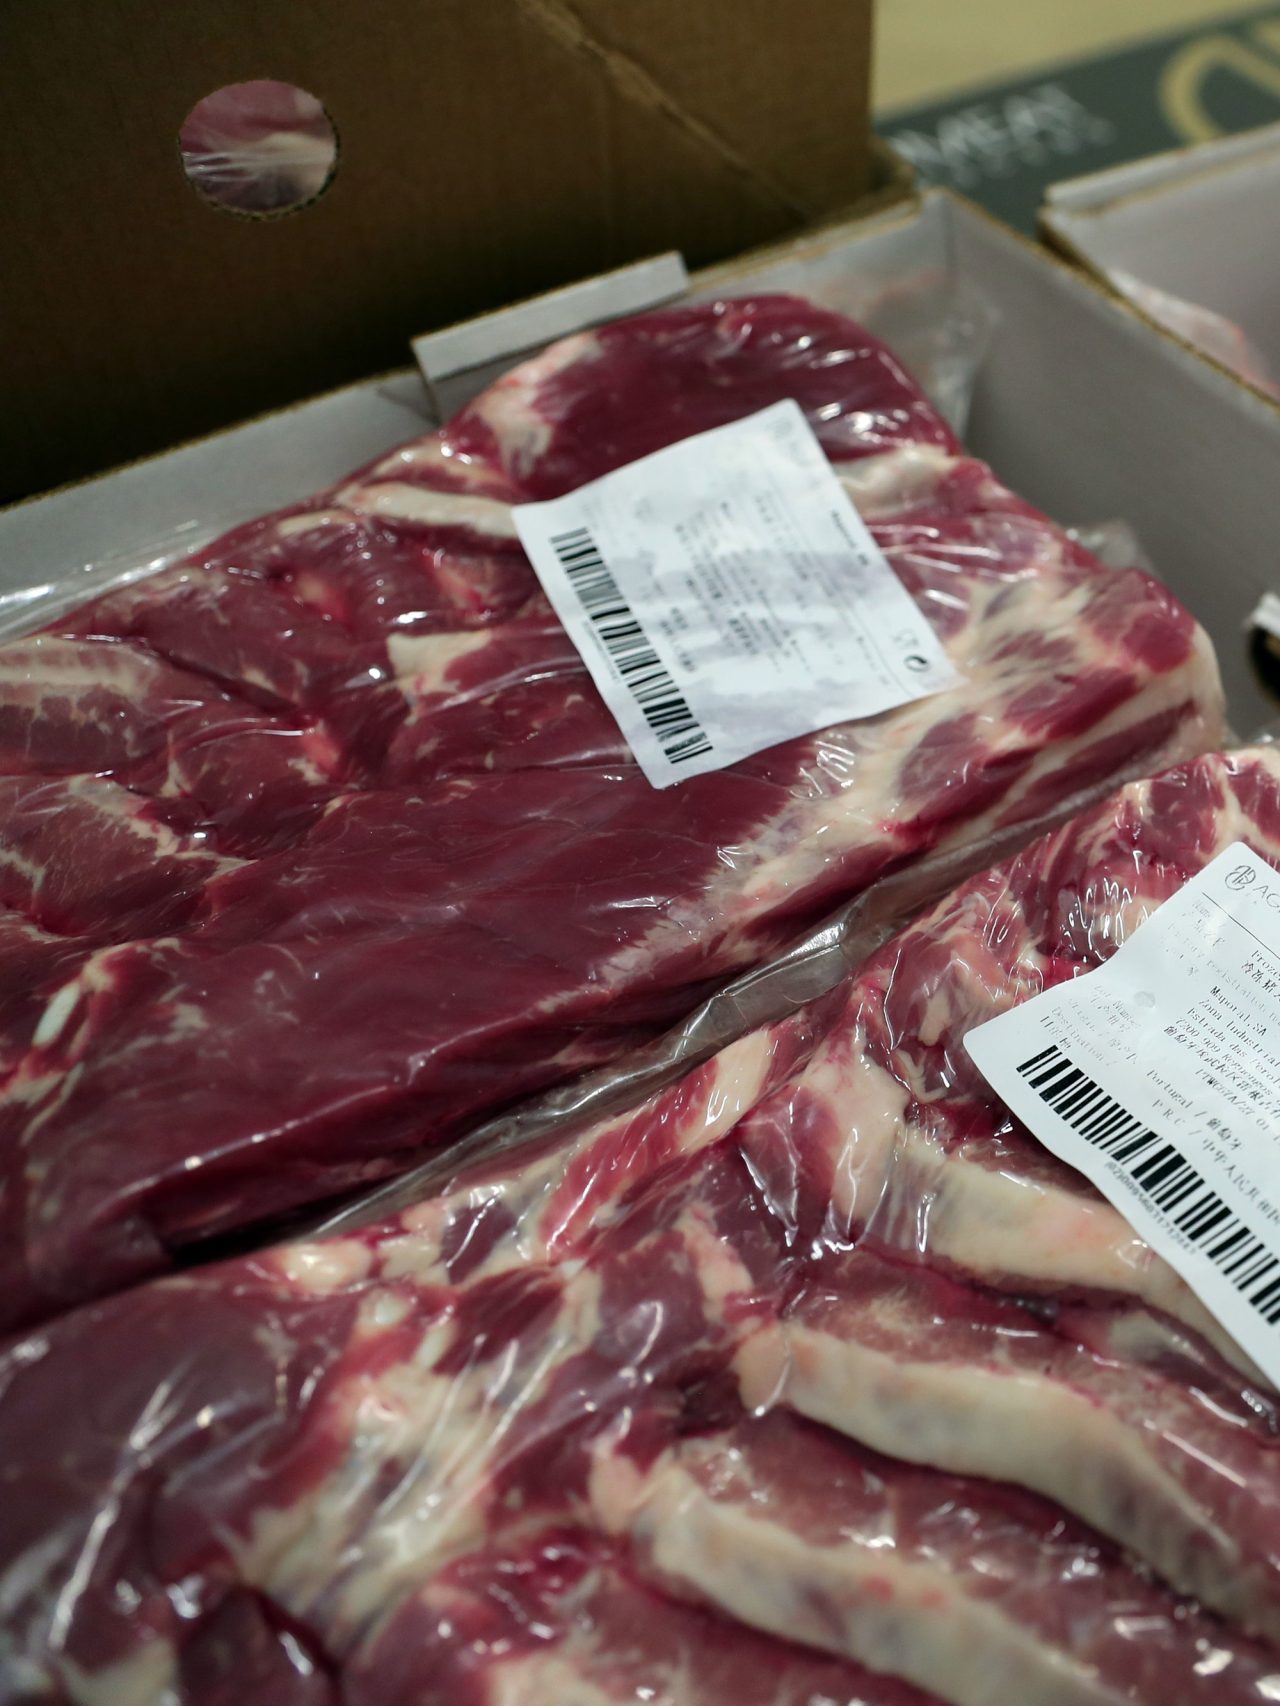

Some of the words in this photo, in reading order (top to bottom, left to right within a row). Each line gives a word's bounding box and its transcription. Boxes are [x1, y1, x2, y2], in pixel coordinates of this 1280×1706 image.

[1186, 1007, 1226, 1042] Estrada
[1228, 1043, 1247, 1057] das
[1146, 1069, 1193, 1108] Portugal
